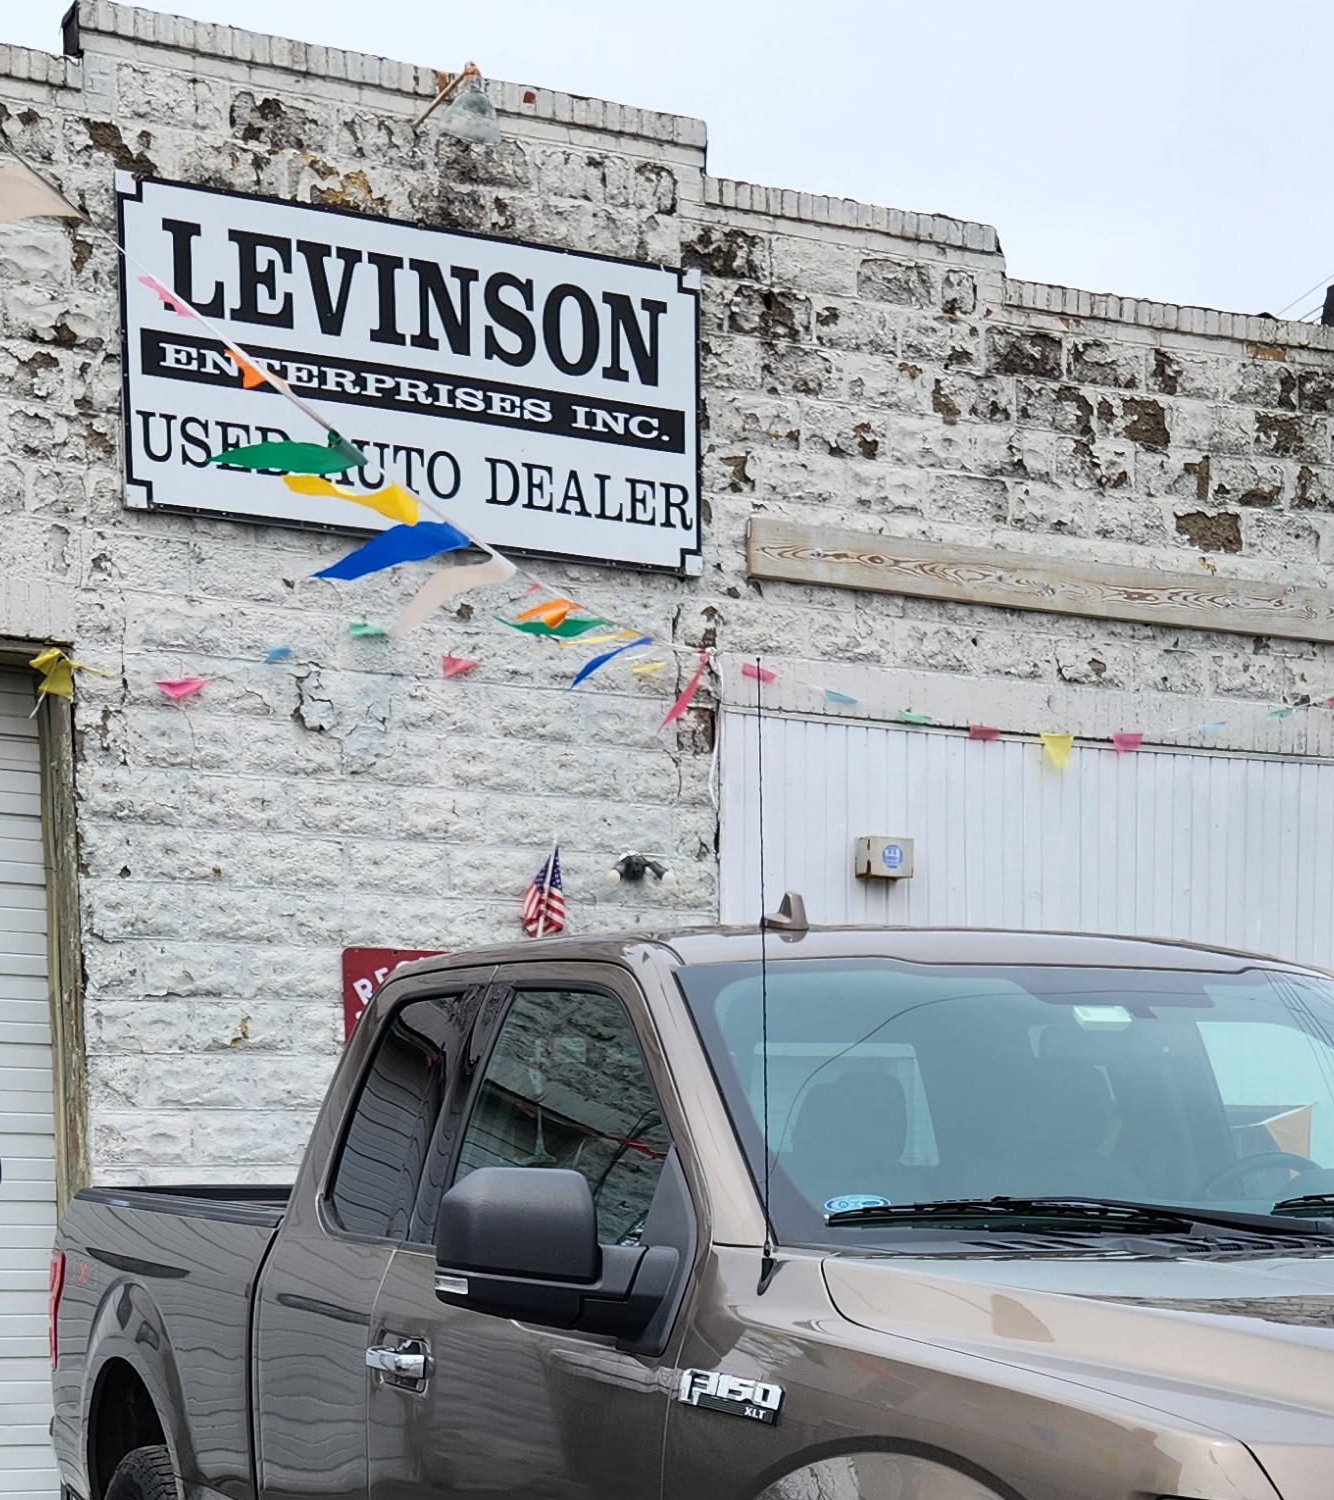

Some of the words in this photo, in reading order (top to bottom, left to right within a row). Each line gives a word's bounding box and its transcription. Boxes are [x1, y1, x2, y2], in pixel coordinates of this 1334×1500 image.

[162, 217, 668, 388] LEVINSON
[158, 342, 552, 424] ENTERPRISES
[570, 404, 670, 442] INC.
[317, 438, 461, 500] UTO
[485, 456, 693, 531] DEALER
[744, 1406, 767, 1420] XLT
